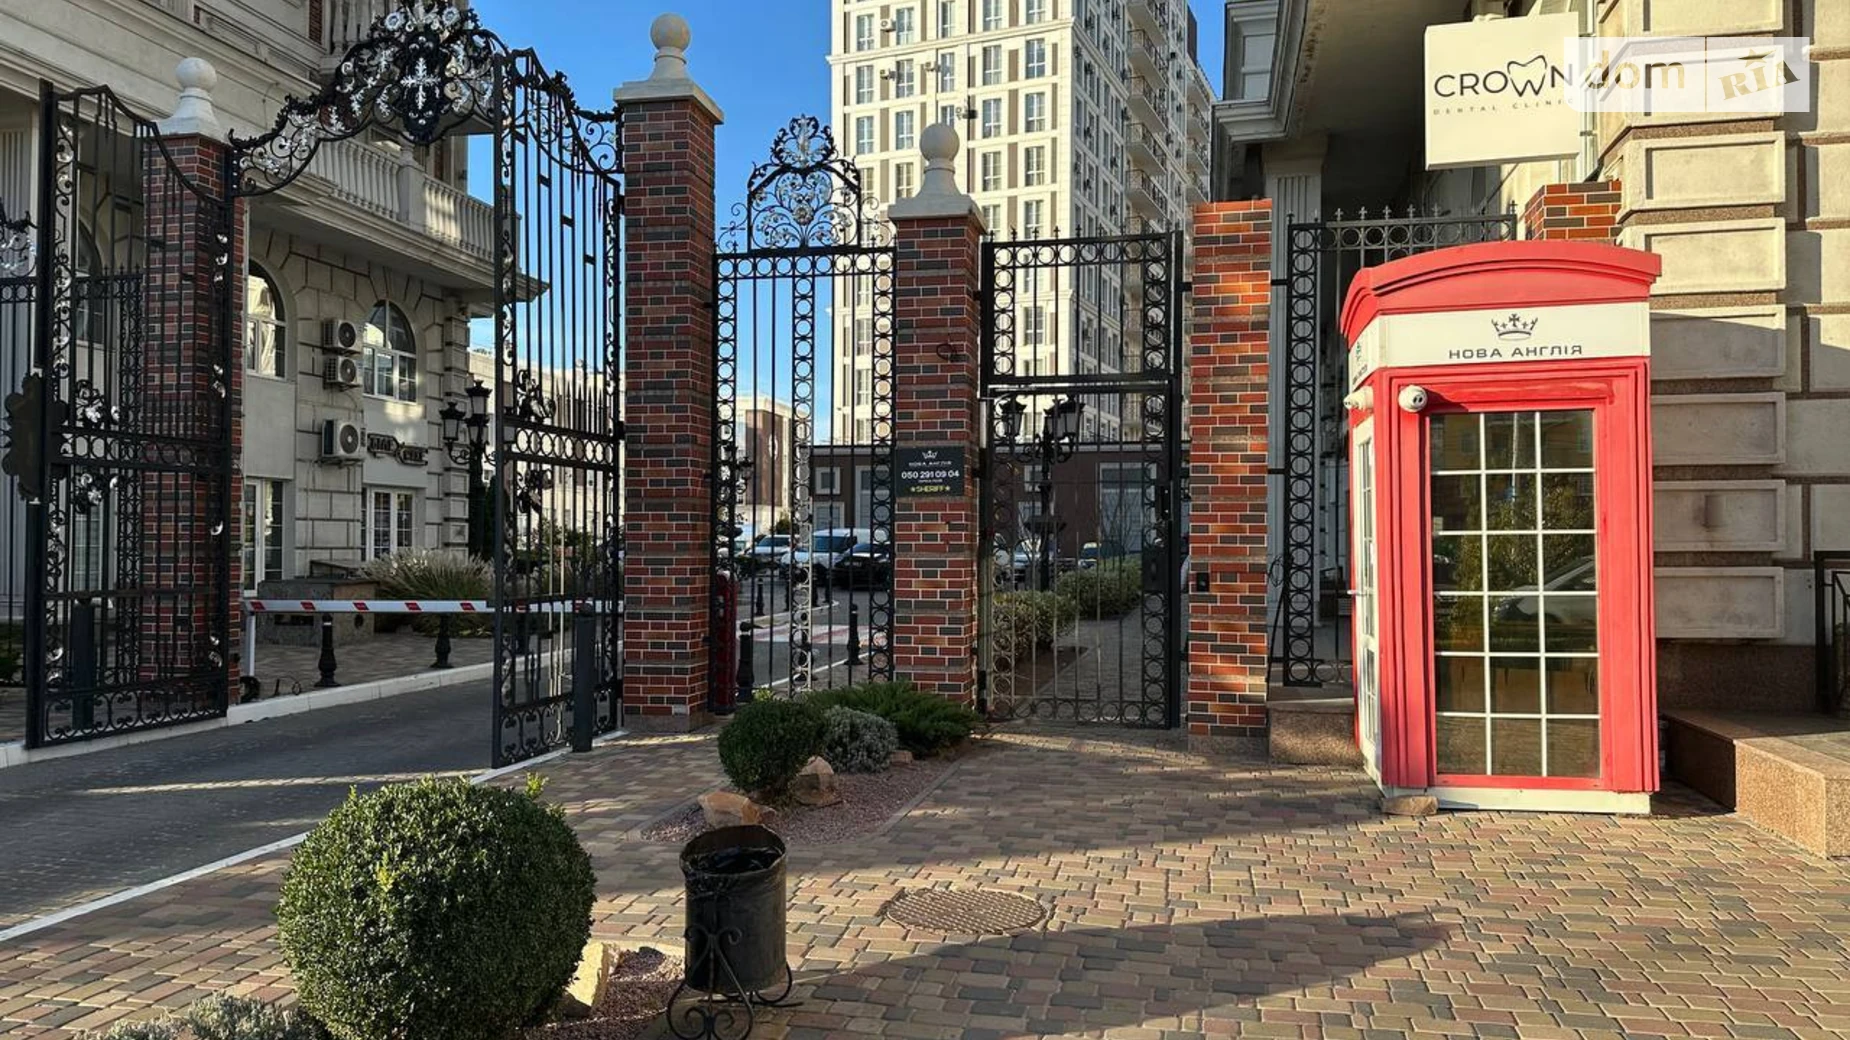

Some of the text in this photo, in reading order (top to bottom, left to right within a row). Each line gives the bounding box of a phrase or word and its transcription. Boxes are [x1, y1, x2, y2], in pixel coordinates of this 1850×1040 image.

[1434, 55, 1573, 98] CROWN
[1433, 98, 1573, 116] DENTAL CLINIC
[1449, 345, 1583, 360] НОВА АНГЛІЯ
[901, 470, 919, 479] 050
[948, 469, 960, 478] 04
